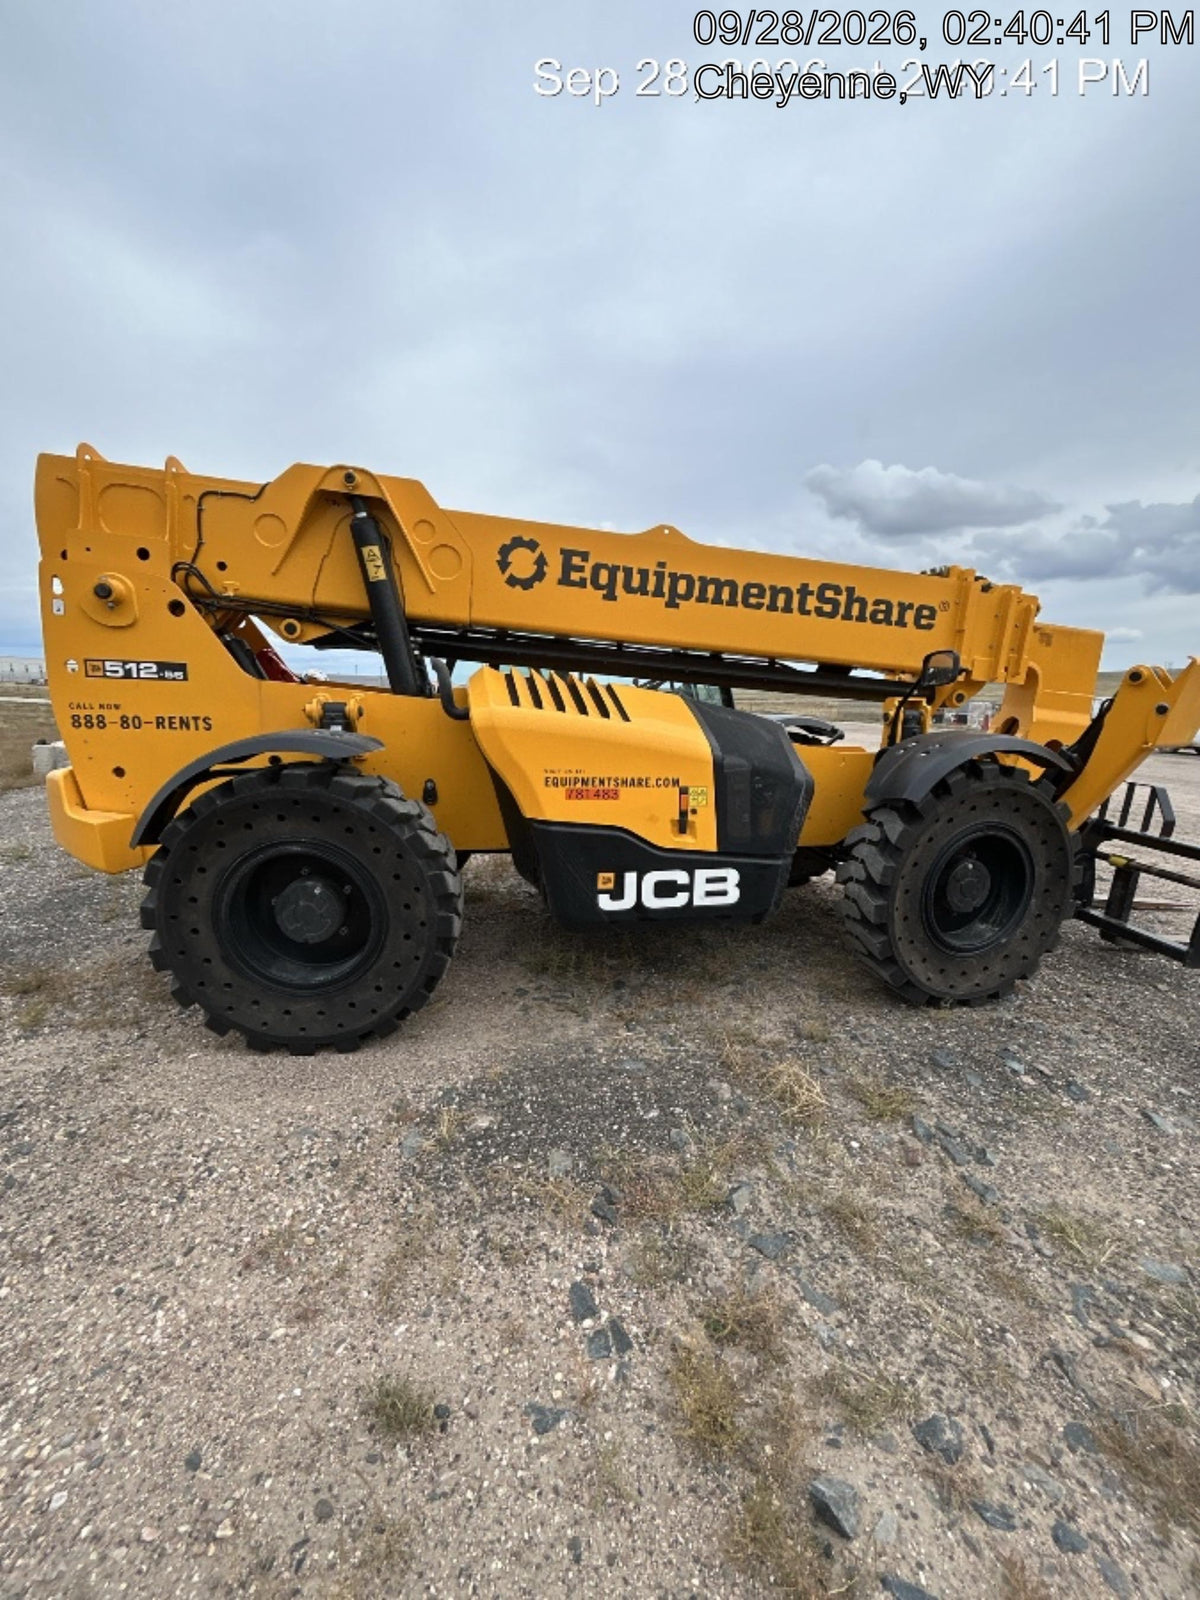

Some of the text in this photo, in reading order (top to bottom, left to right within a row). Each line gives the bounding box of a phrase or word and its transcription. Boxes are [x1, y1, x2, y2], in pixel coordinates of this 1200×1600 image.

[68, 702, 94, 710] CALL
[71, 714, 213, 732] 888-80-RENTS
[544, 776, 680, 788] EQUIPMENTSHARE.COM
[597, 868, 740, 911] JCB
